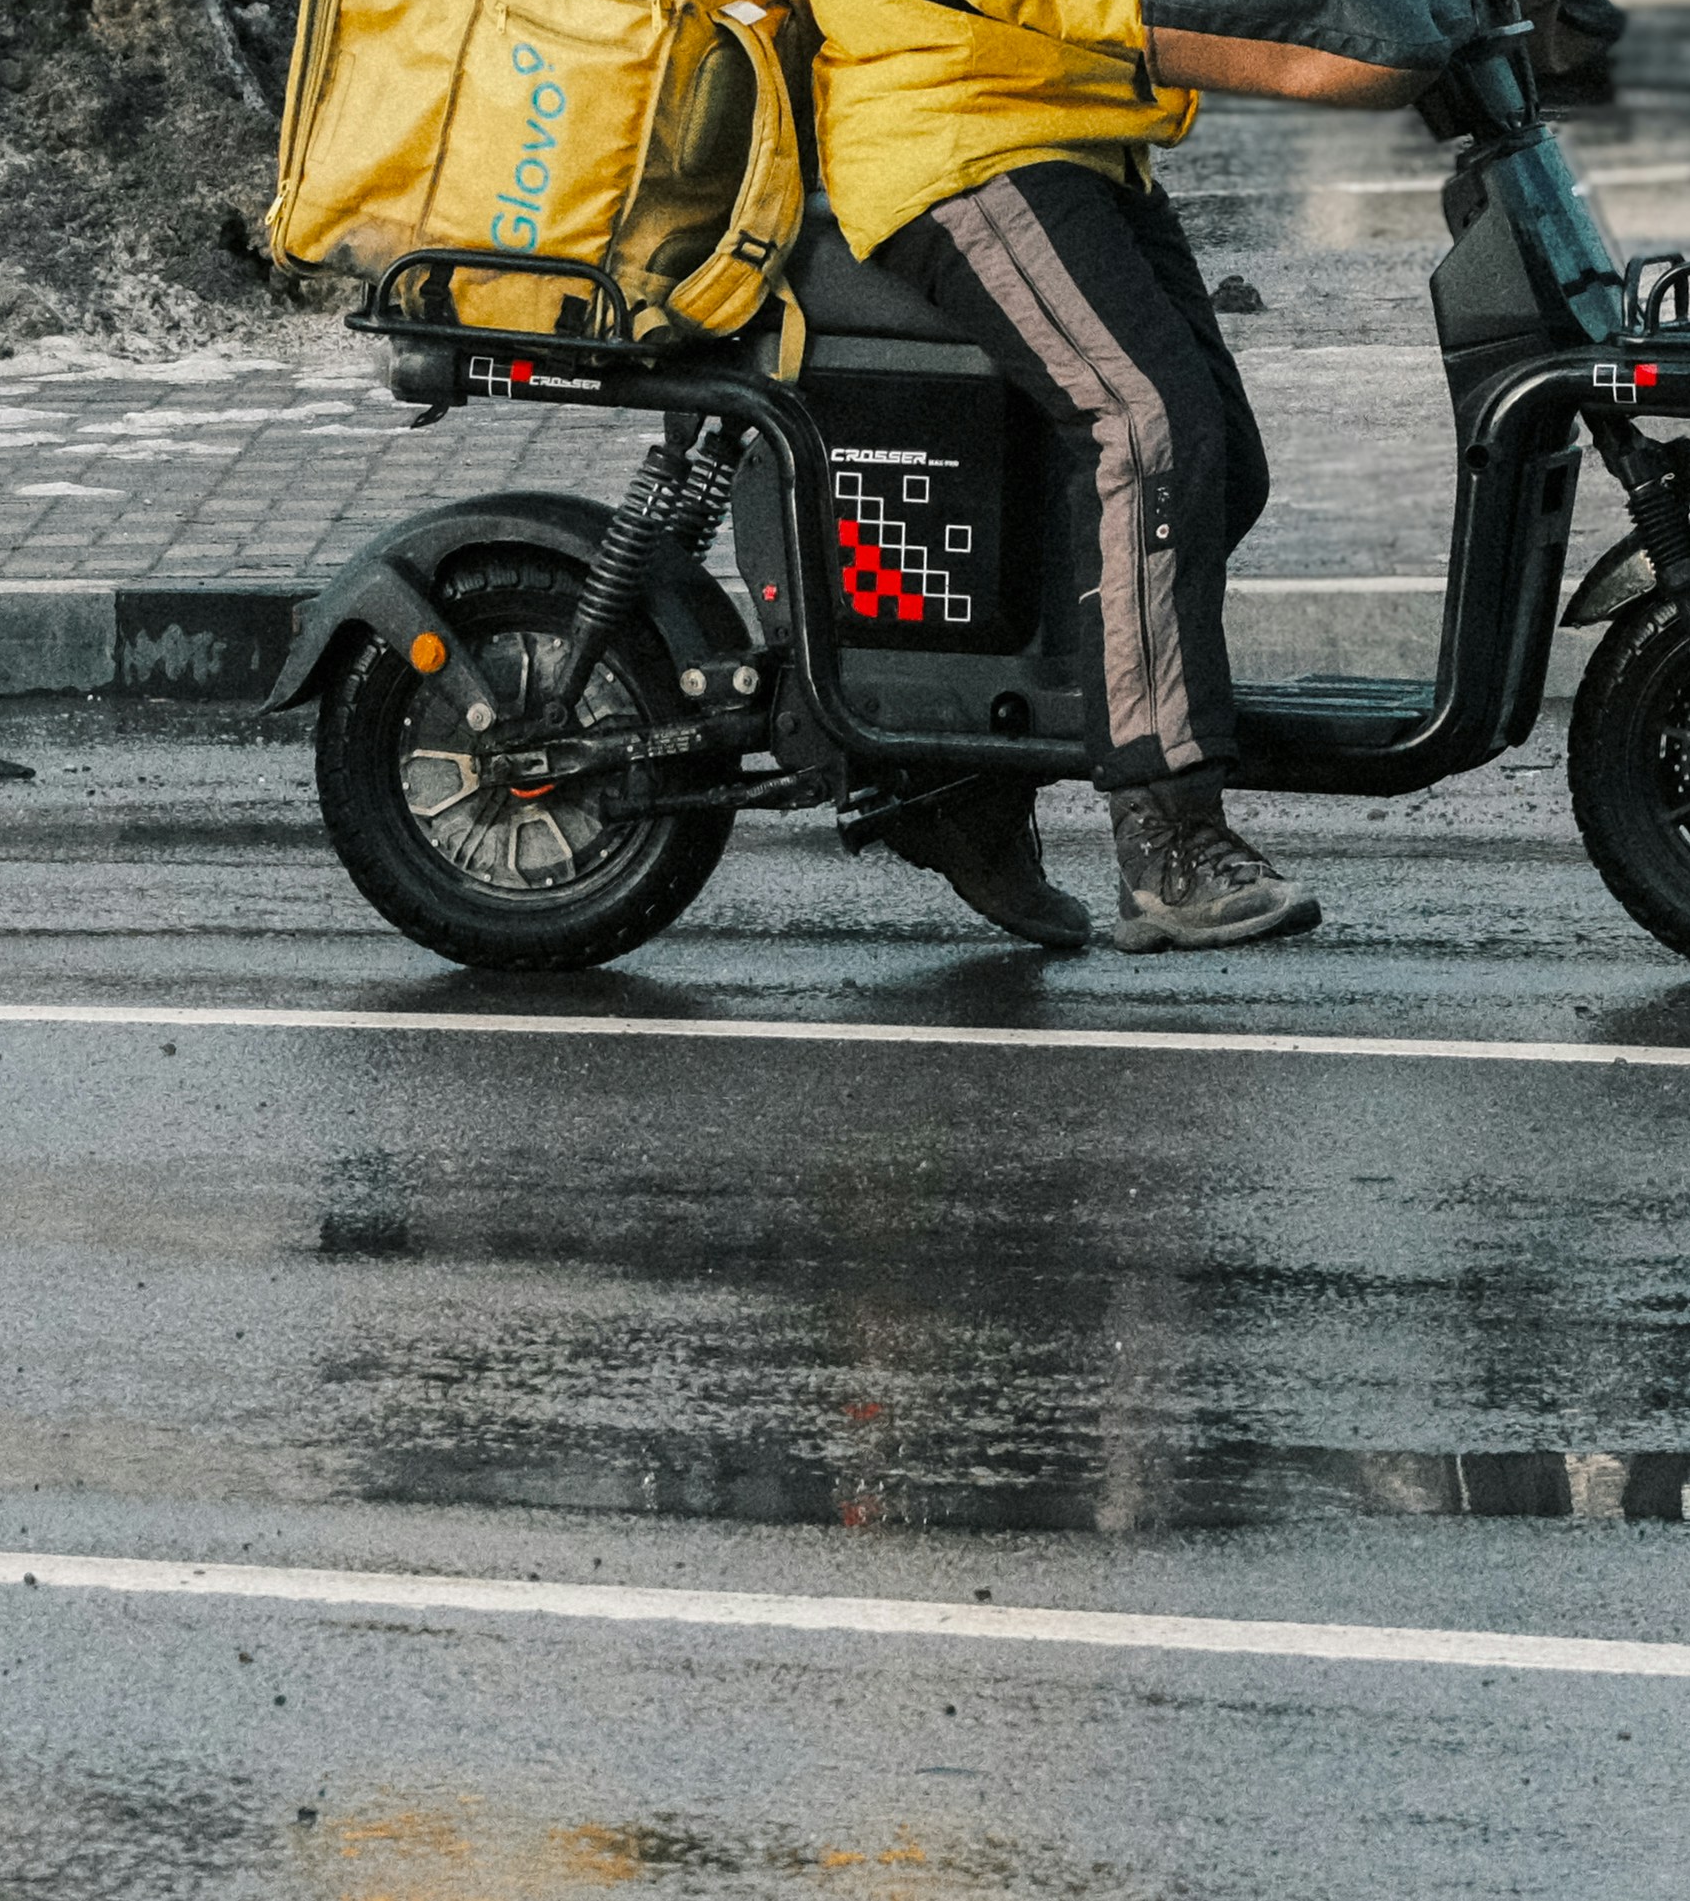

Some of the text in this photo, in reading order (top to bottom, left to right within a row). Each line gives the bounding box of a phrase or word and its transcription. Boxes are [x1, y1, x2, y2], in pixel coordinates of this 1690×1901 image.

[491, 80, 567, 256] Glovo
[529, 375, 601, 390] CROSSER
[831, 449, 927, 465] CROSSER
